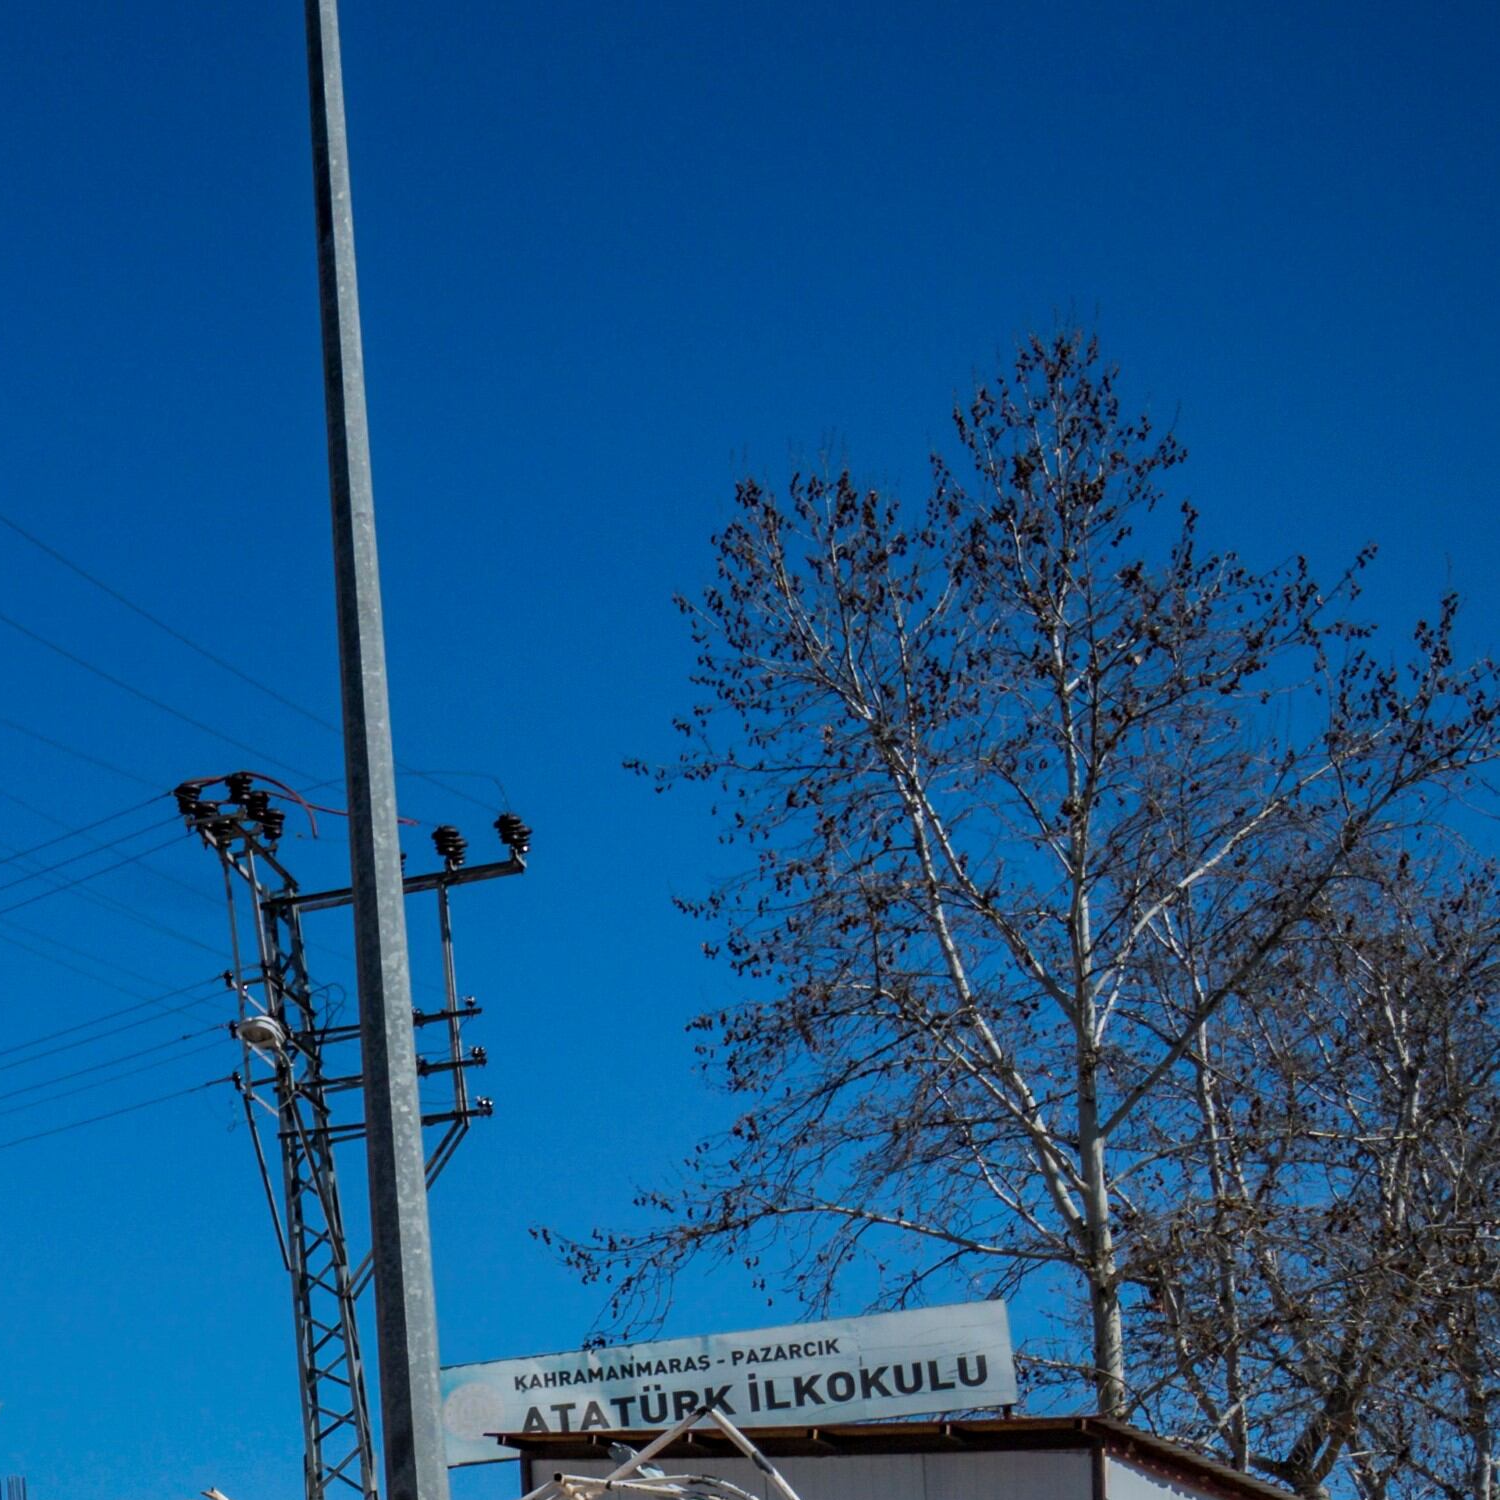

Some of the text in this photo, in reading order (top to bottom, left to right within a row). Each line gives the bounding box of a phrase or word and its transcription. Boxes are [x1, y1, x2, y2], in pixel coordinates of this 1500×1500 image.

[514, 1355, 710, 1391] KAHRAMANMARAŞ
[732, 1338, 840, 1366] PAZARCIK
[522, 1354, 988, 1433] ATATÜRK İLKOKULU
